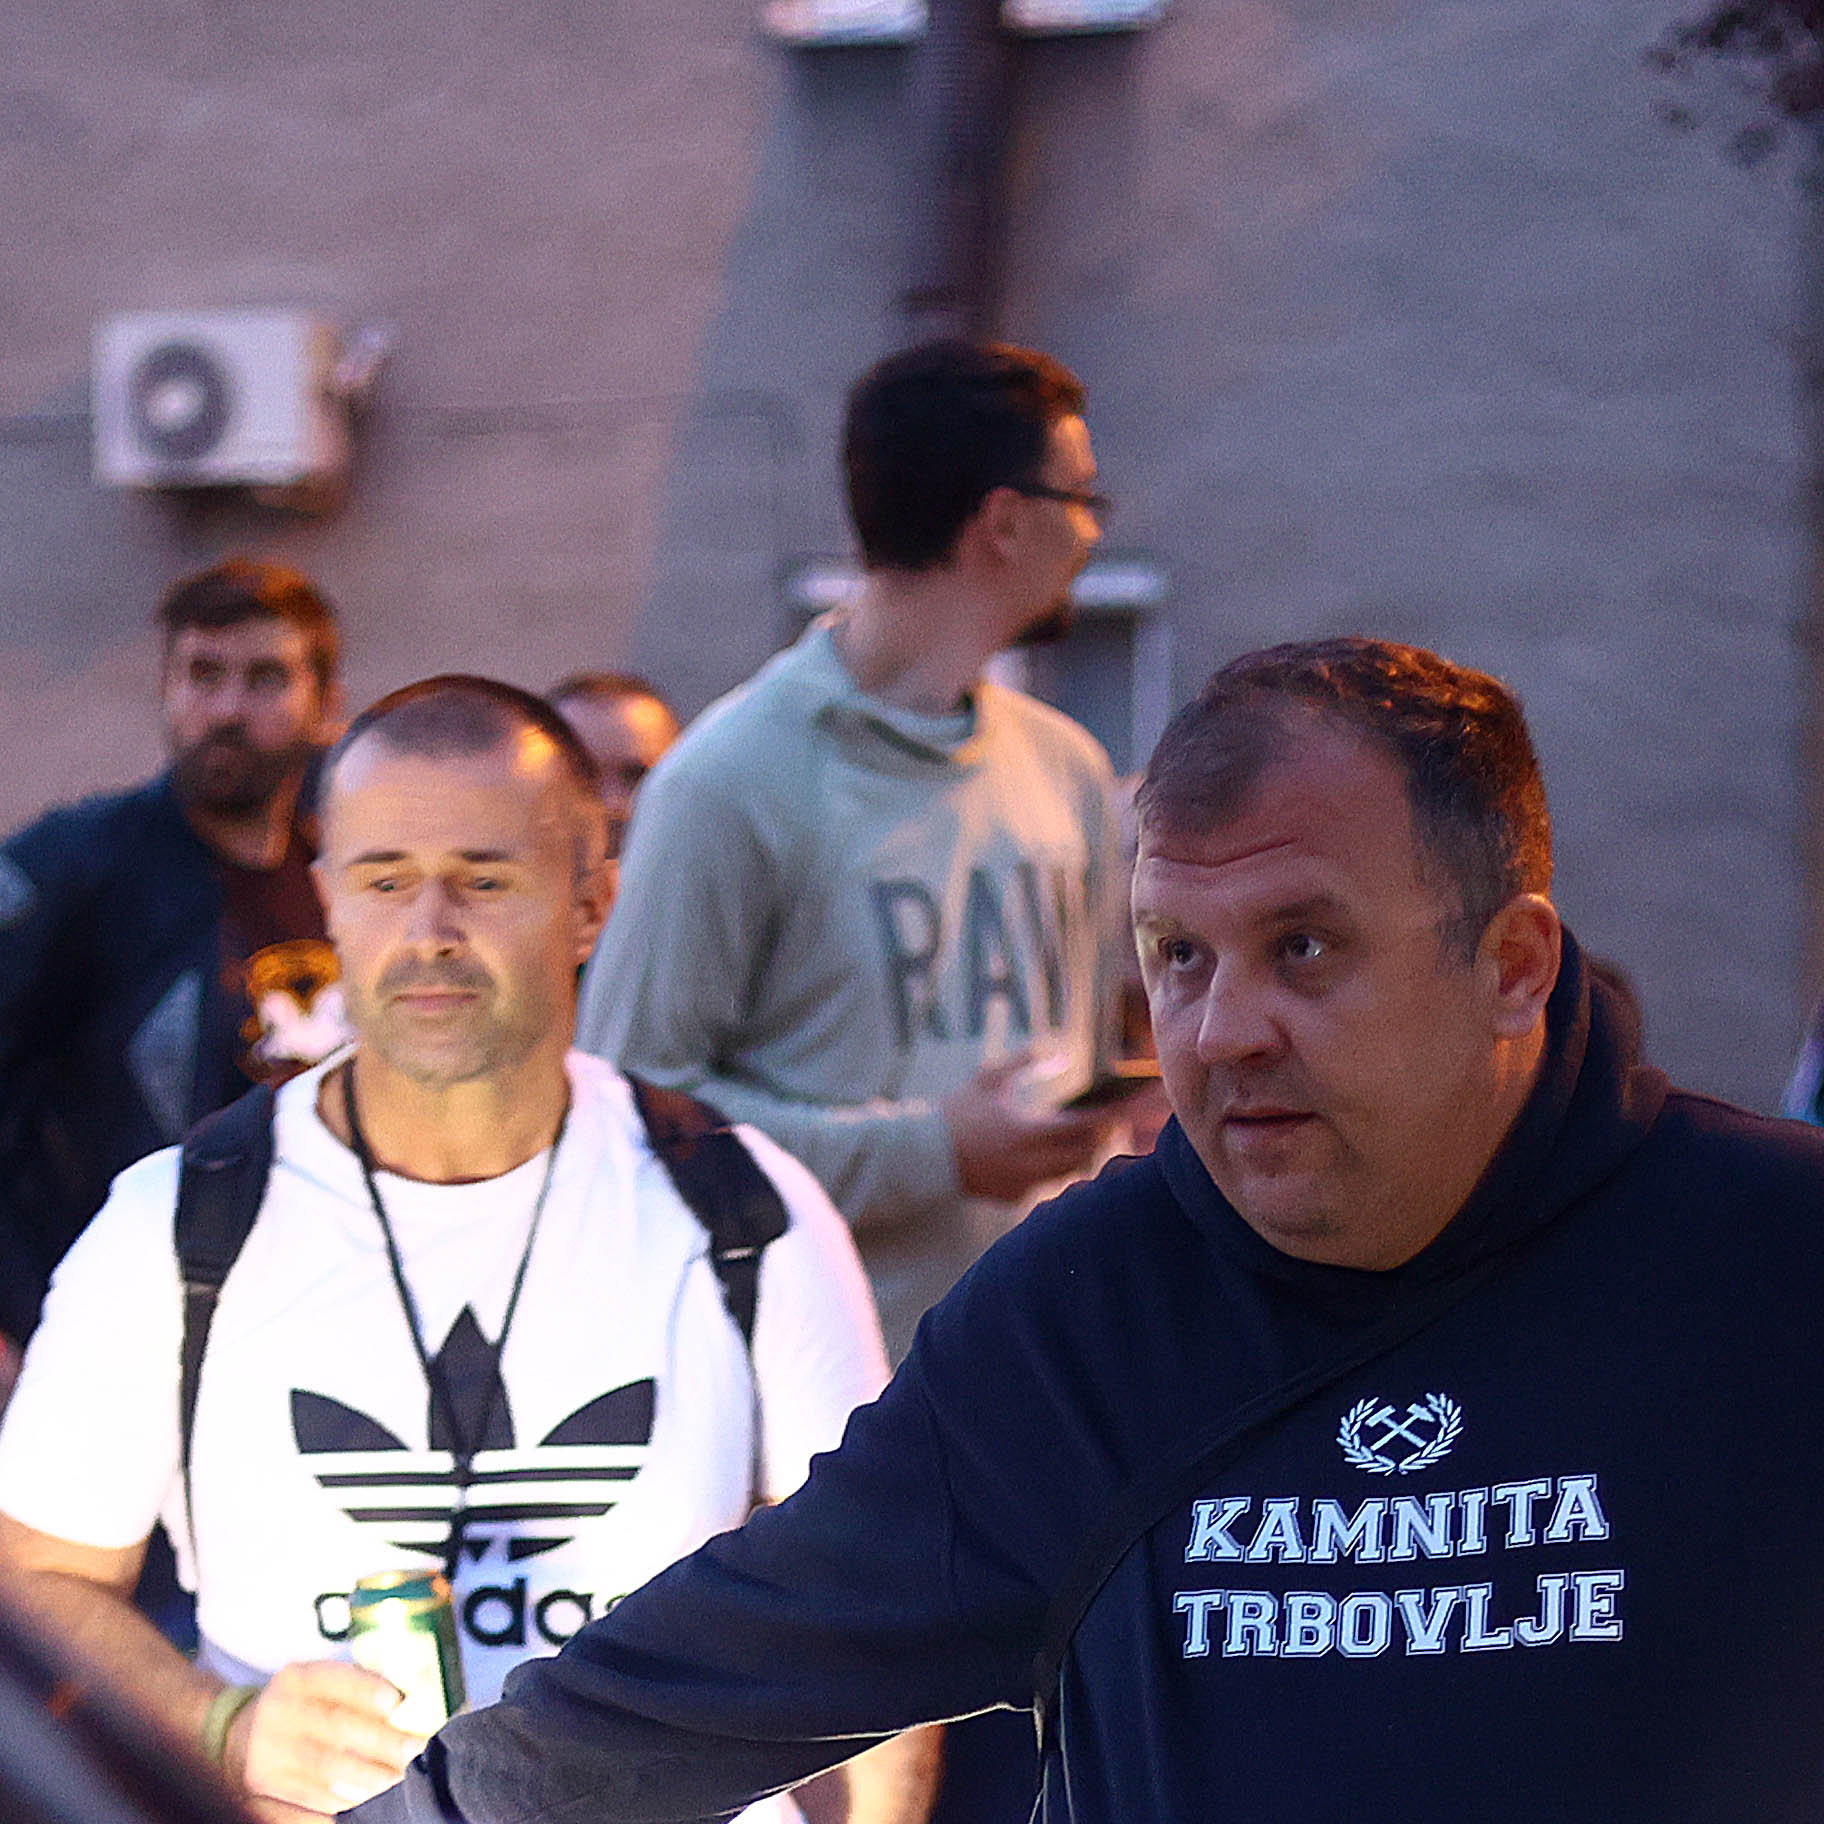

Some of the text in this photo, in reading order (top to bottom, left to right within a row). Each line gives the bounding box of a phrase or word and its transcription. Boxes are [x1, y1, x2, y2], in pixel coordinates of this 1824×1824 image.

[1184, 1473, 1610, 1564] KAMNITA
[312, 1575, 626, 1648] ada
[1172, 1568, 1625, 1659] TRBOVLJE
